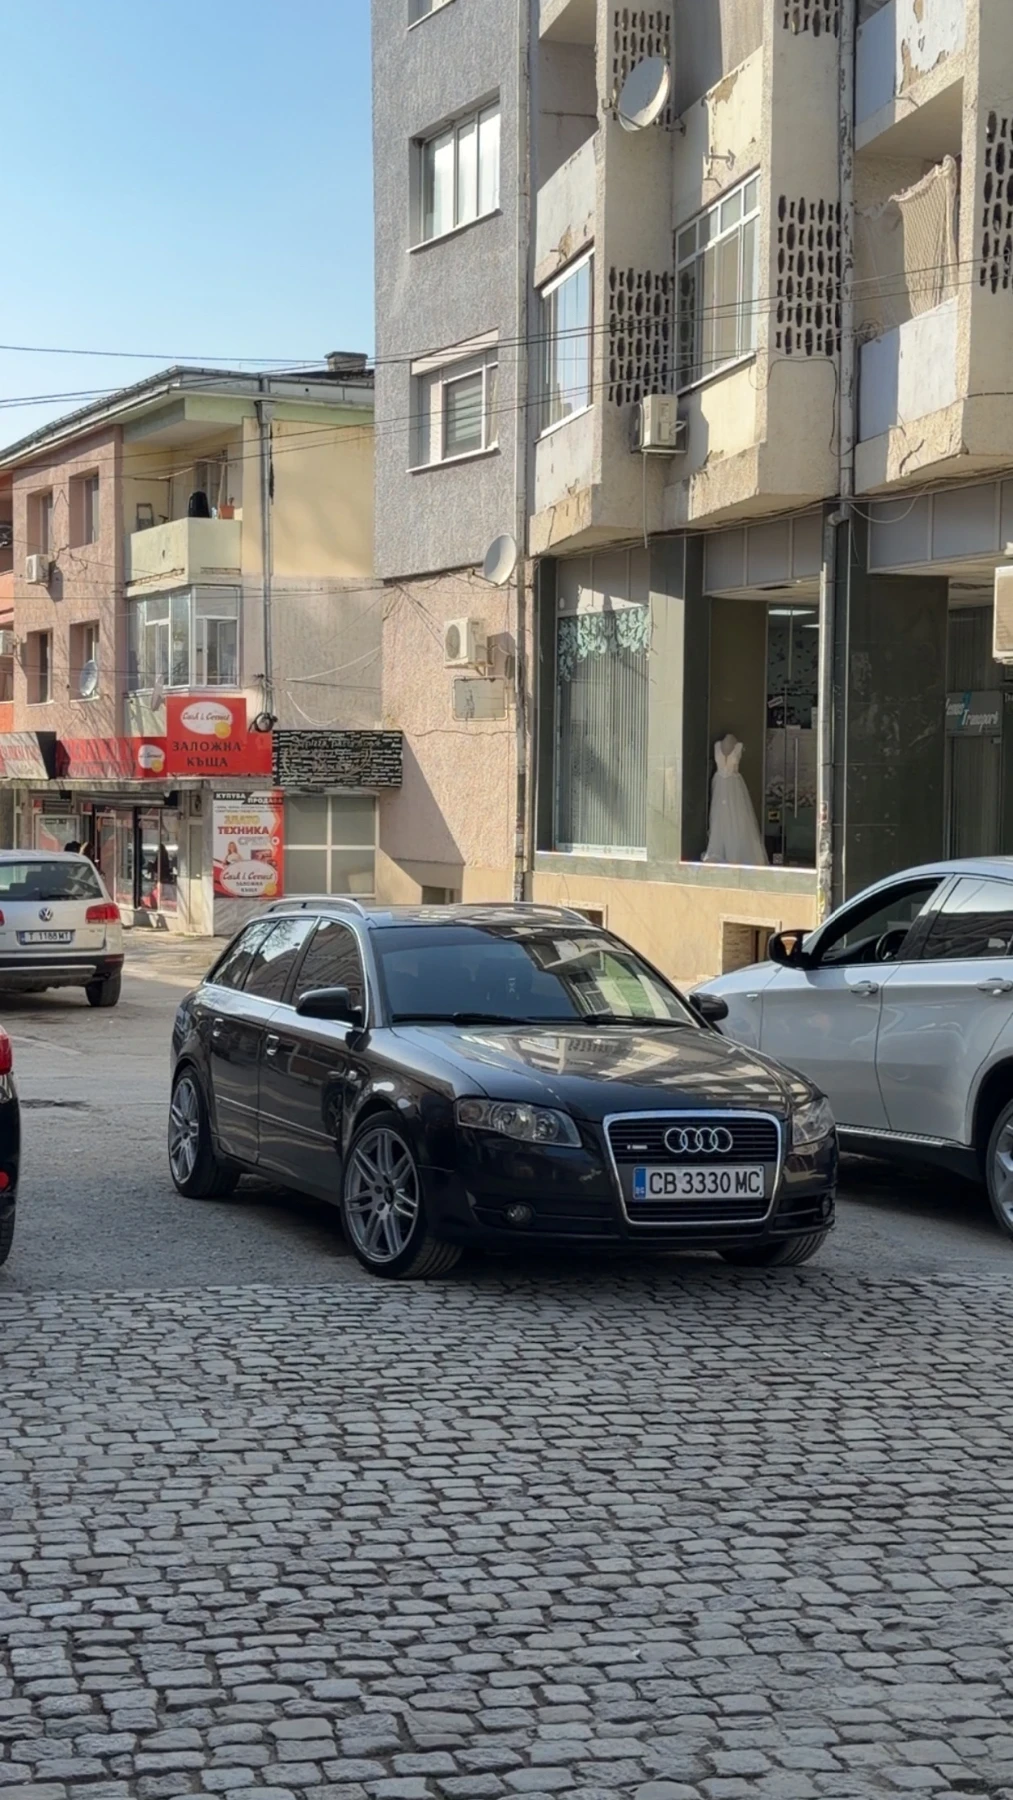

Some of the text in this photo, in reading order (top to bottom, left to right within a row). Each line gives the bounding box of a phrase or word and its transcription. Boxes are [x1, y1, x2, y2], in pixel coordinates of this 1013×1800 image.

[172, 741, 242, 751] ЗАЛОЖНА
[187, 756, 228, 768] КЪЩА
[217, 826, 270, 835] ТЕХНИКА
[649, 1171, 761, 1195] CB 3330 MC
